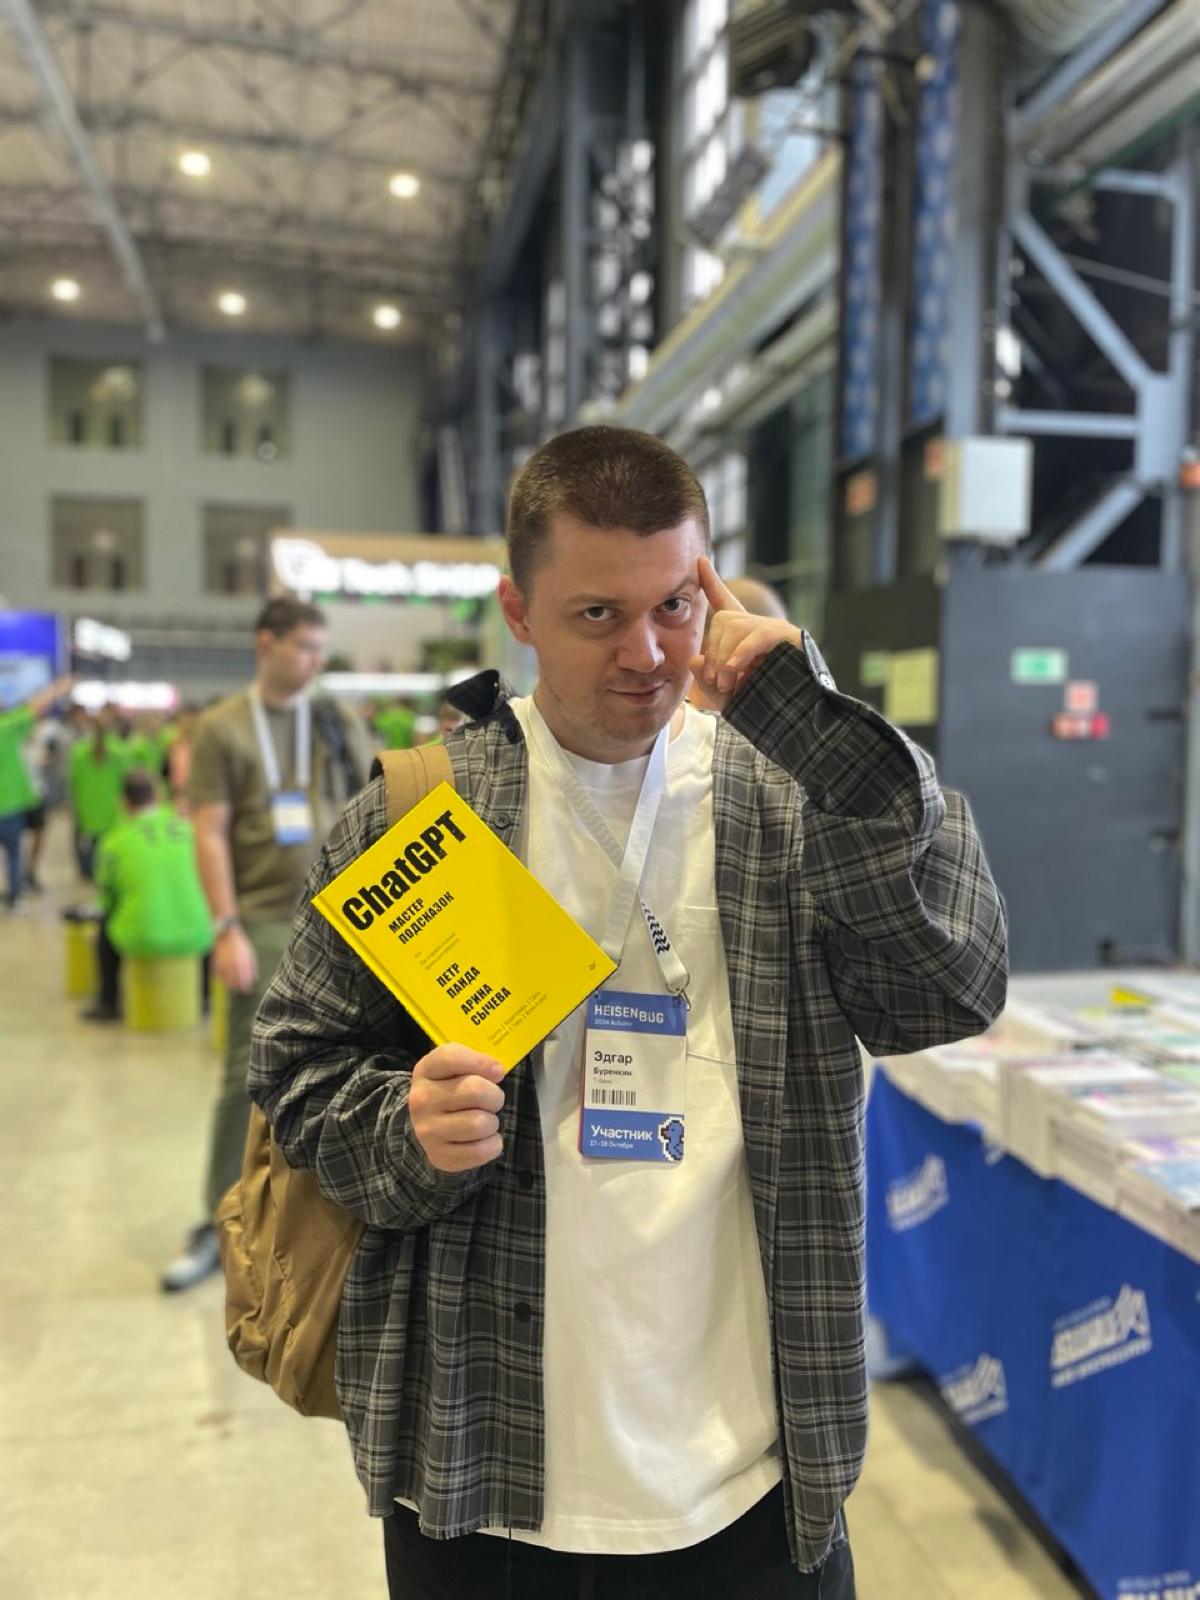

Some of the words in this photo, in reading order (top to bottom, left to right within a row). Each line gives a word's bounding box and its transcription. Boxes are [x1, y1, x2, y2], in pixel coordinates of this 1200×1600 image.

[342, 810, 467, 931] ChatGPT
[389, 898, 425, 934] МАСТЕР
[399, 891, 455, 945] ПОДСКАЗОК
[436, 963, 461, 987] ПЕТР
[446, 966, 481, 999] ПАНДА
[460, 983, 493, 1016] АРИНА
[471, 986, 512, 1026] СЫЧЕВА
[594, 1004, 665, 1024] HEISENBUG
[594, 1050, 633, 1066] Эдгар
[591, 1124, 653, 1141] Участник
